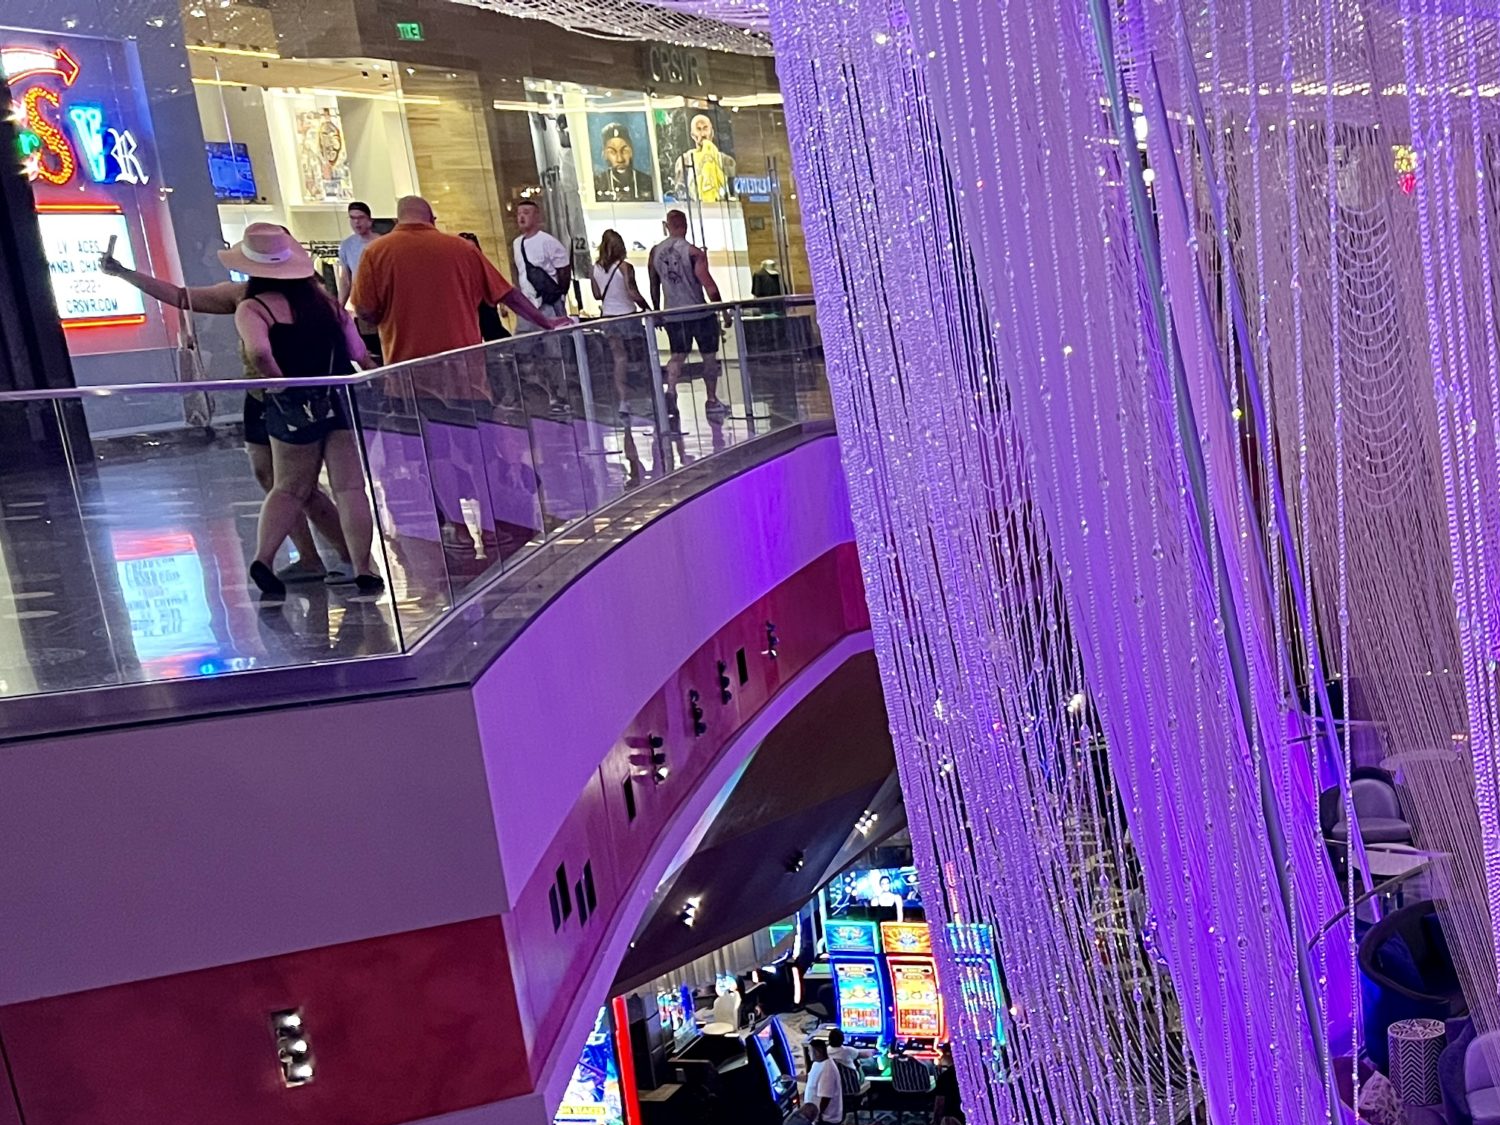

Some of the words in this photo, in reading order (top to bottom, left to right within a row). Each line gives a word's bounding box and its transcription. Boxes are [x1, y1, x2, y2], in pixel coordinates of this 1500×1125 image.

[650, 46, 702, 86] CRSVR
[78, 240, 100, 253] ACES
[66, 298, 118, 314] CRSVR.COM
